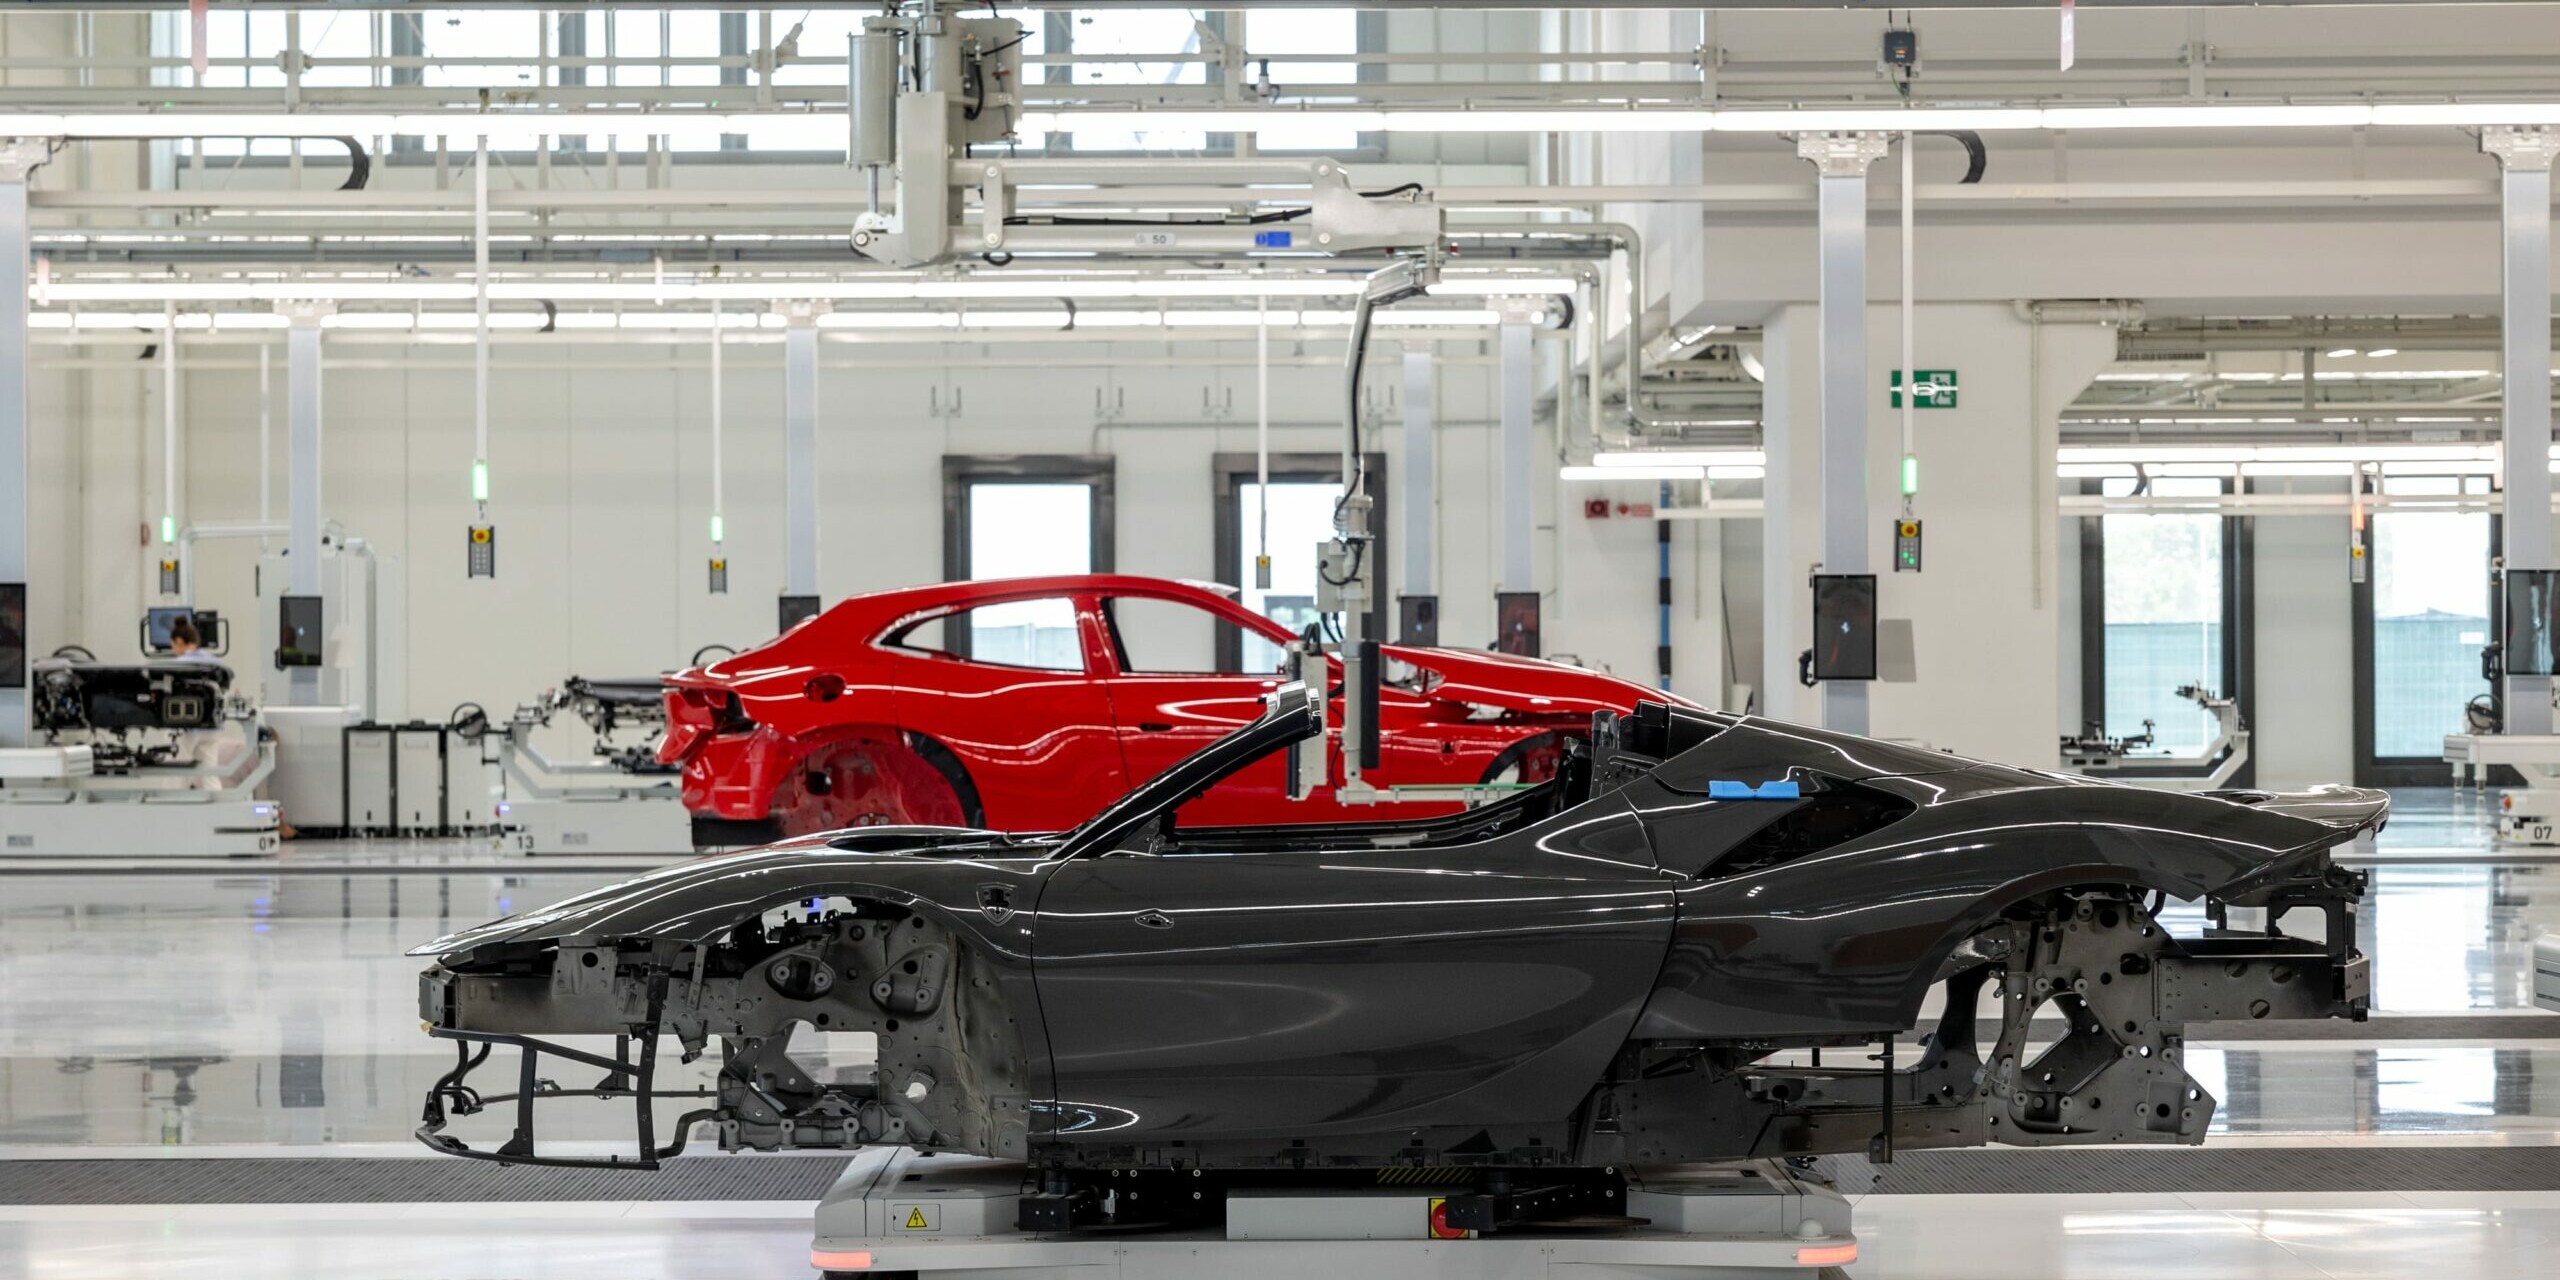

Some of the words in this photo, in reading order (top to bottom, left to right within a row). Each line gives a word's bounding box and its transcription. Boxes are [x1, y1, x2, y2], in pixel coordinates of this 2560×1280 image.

[1152, 235, 1167, 244] 50
[2534, 826, 2552, 840] 07
[517, 835, 534, 849] 13
